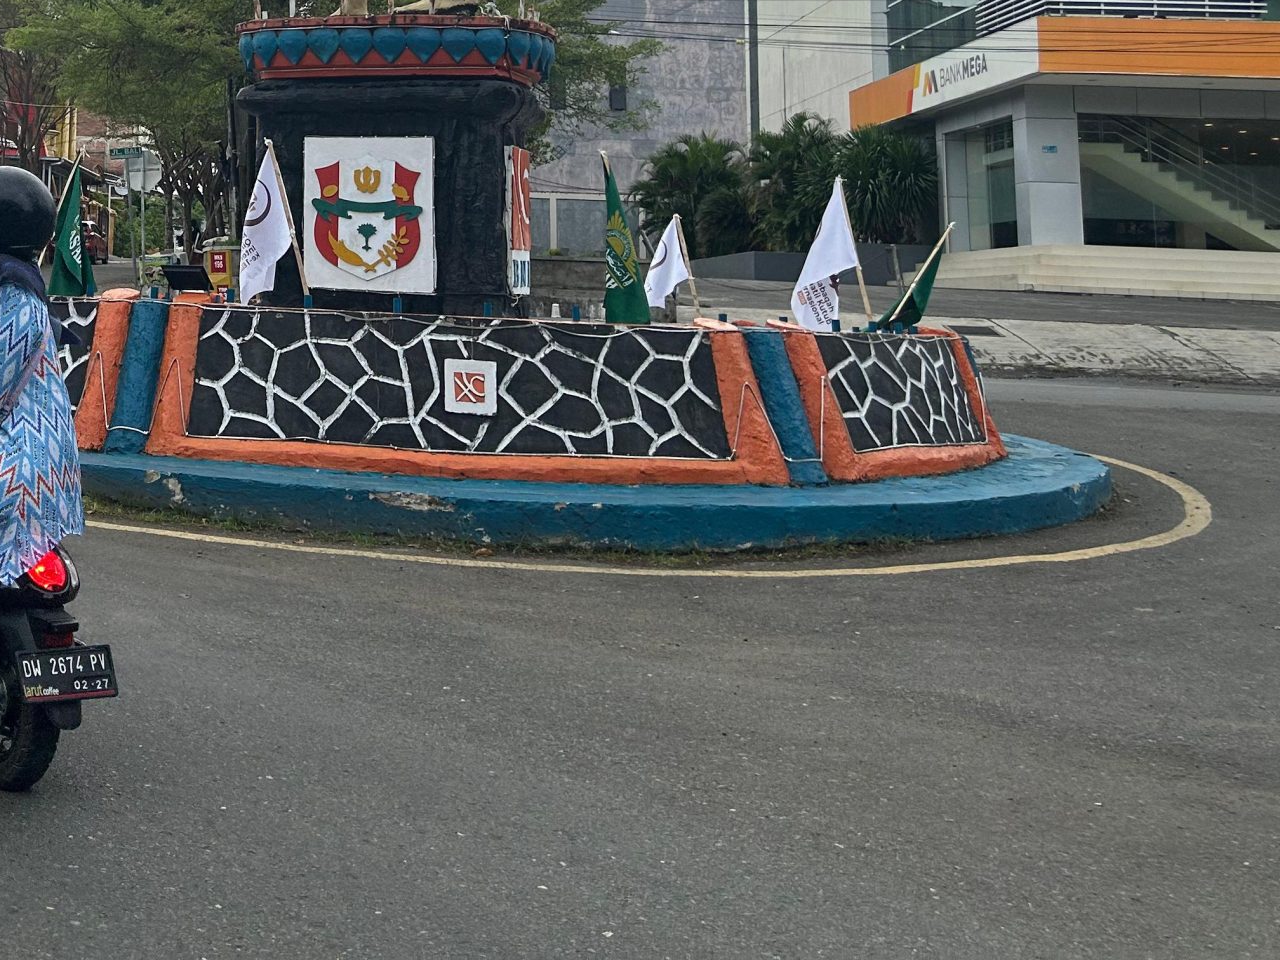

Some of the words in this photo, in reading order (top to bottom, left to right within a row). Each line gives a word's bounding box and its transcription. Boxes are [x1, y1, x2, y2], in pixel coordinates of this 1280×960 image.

[124, 147, 142, 155] BALI
[512, 259, 530, 288] BNI
[22, 658, 42, 678] DW
[49, 654, 84, 675] 2674
[90, 653, 106, 671] PV
[43, 686, 60, 696] coffee
